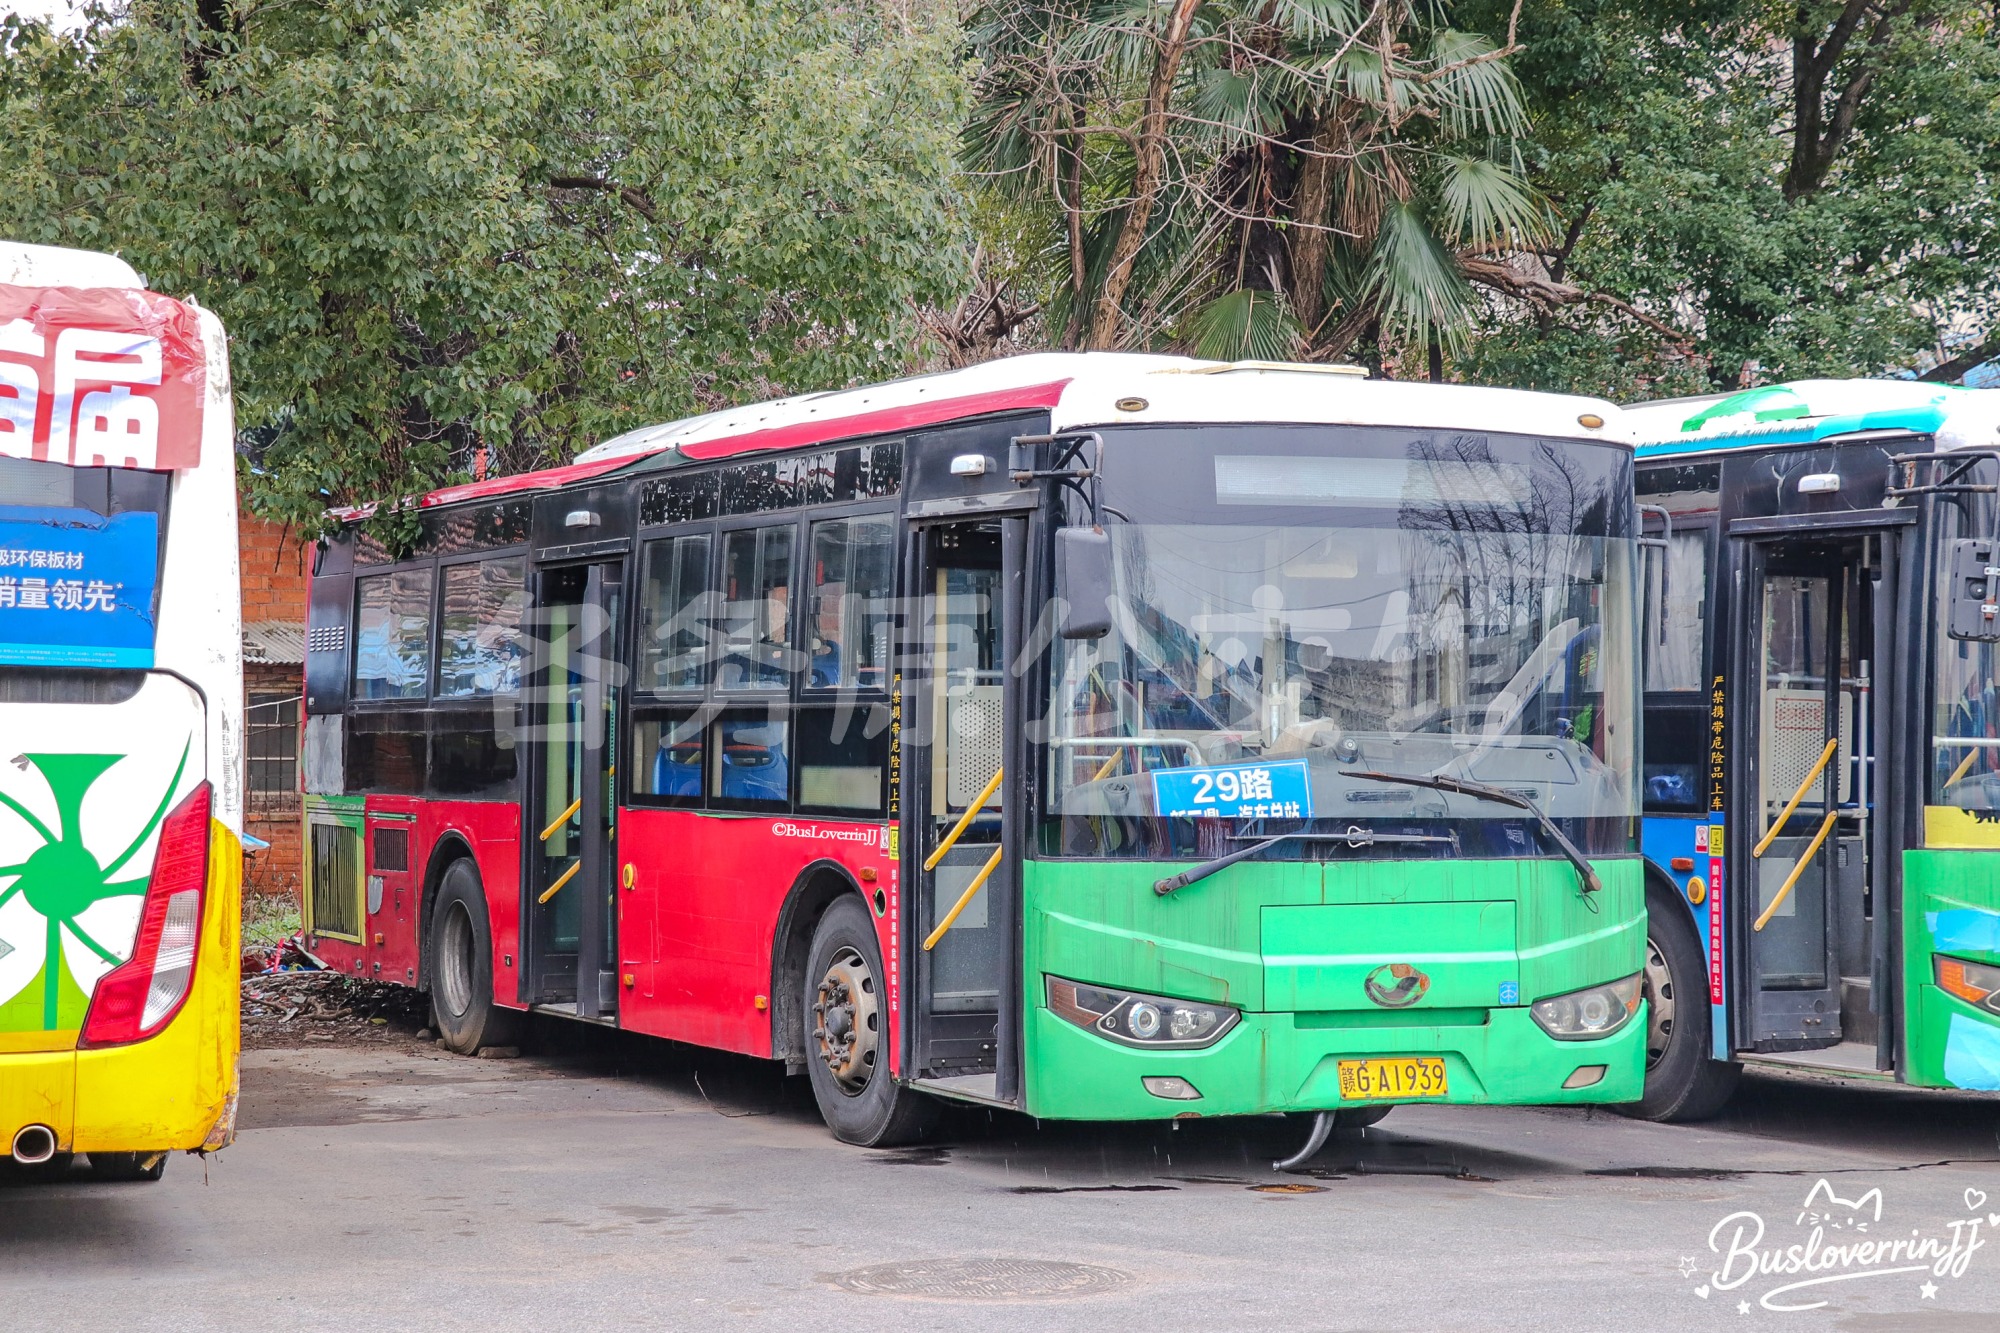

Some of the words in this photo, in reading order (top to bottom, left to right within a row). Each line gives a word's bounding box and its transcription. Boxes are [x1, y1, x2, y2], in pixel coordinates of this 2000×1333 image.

[1191, 768, 1273, 804] 29路
[1711, 675, 1725, 811] 严禁携带危险品上车
